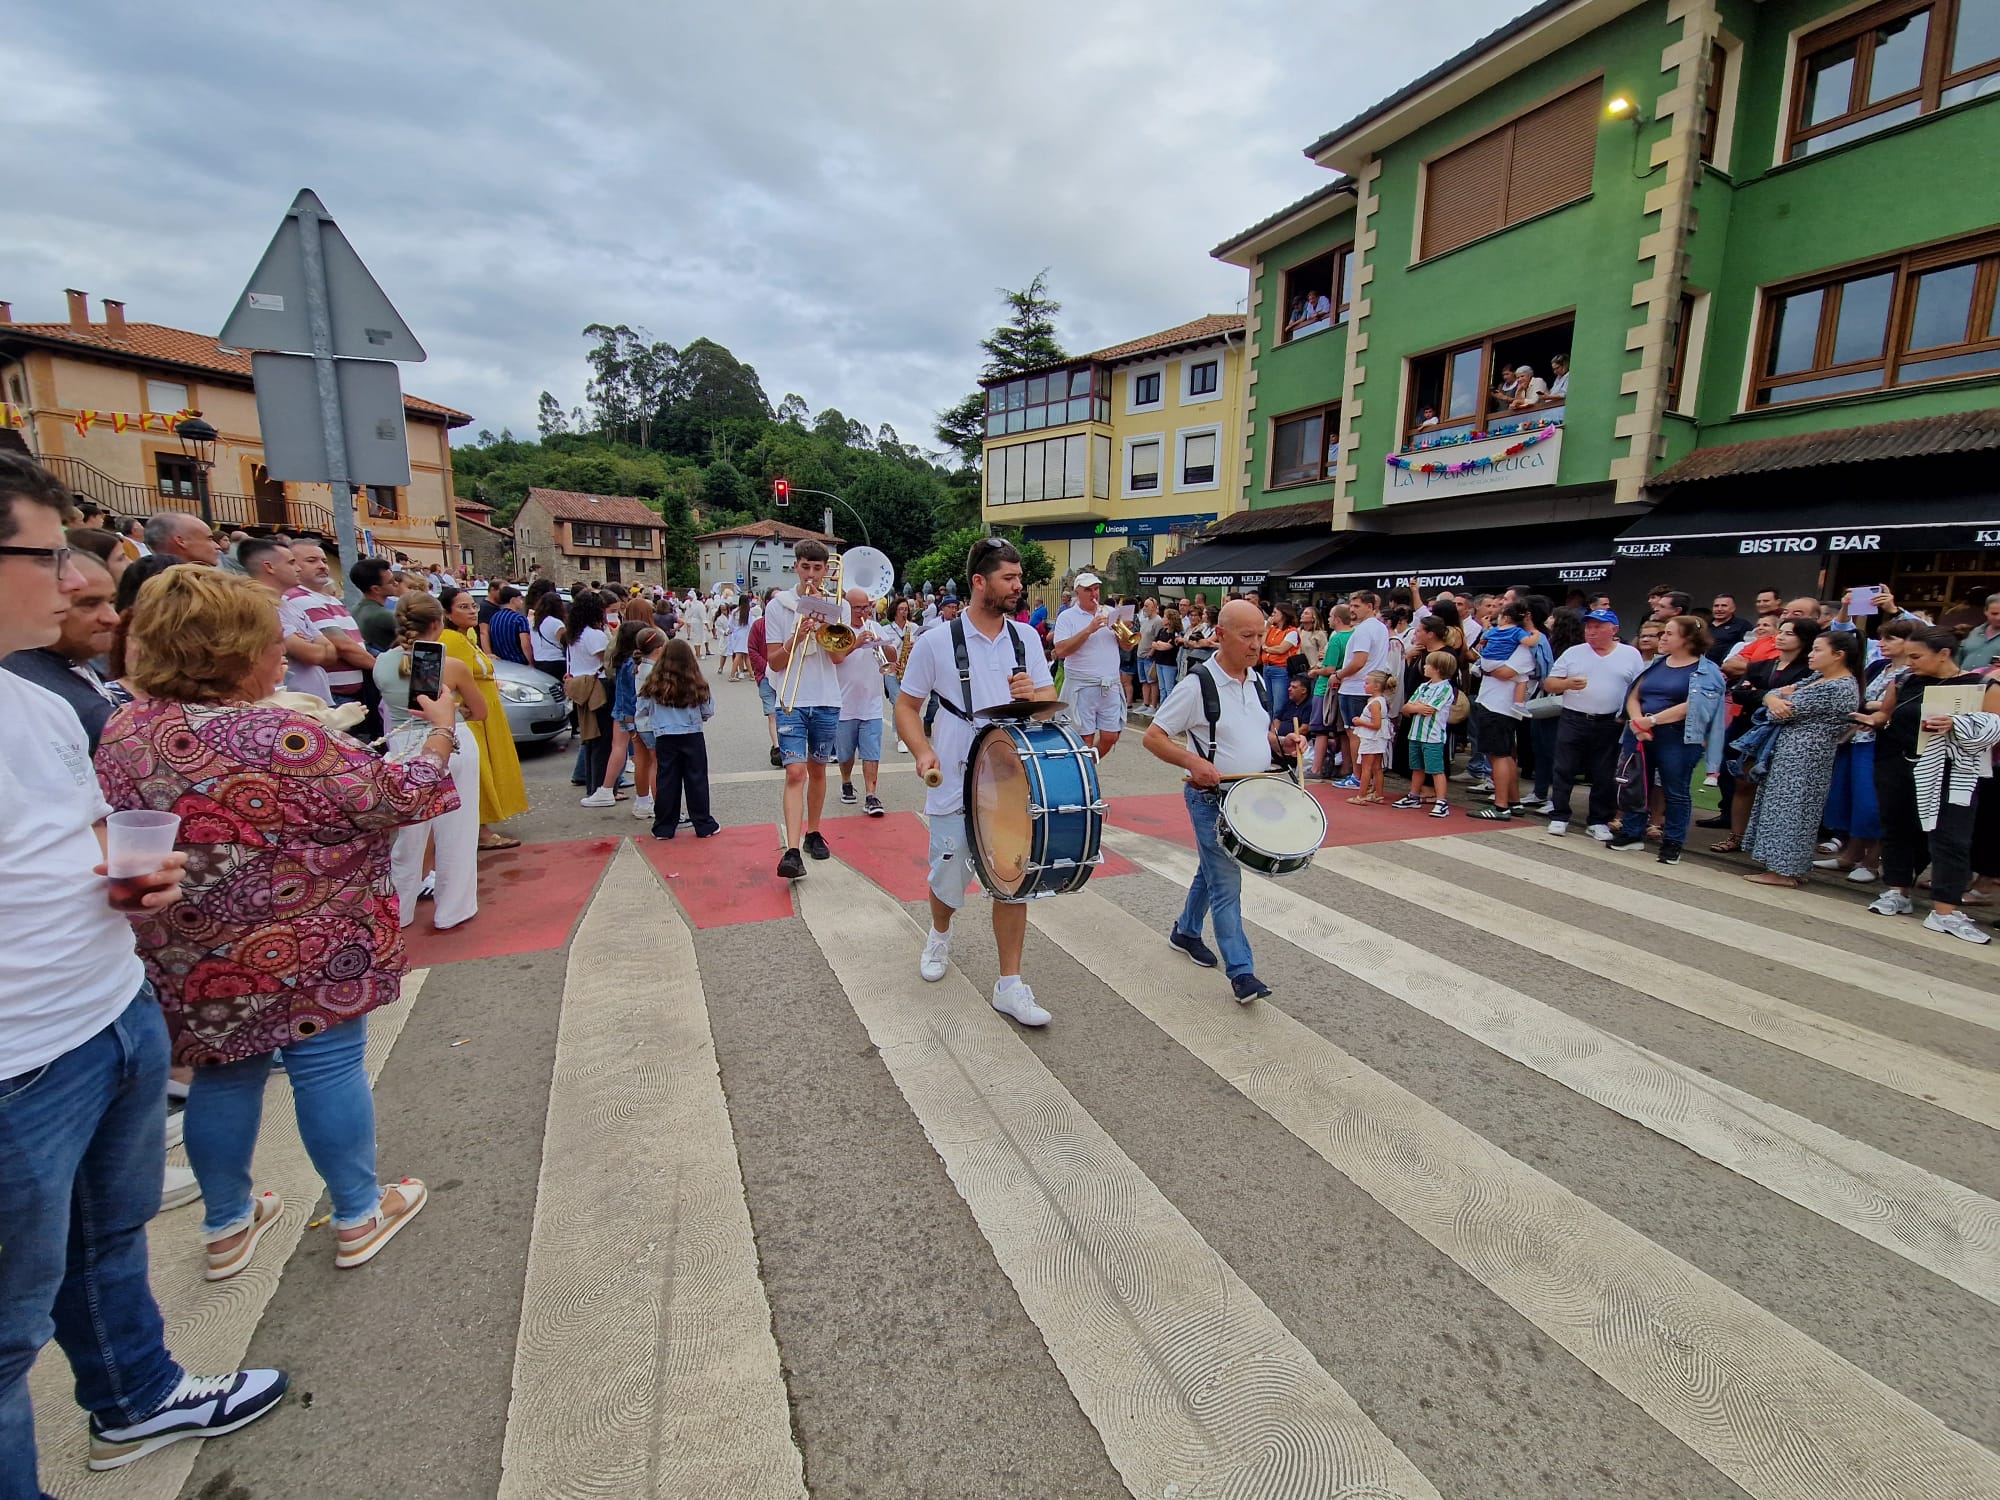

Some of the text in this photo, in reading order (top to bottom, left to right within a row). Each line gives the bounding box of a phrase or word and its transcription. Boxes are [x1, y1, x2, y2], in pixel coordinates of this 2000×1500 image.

[1105, 525, 1129, 534] Unicaja
[1616, 543, 1671, 553] KELER
[1740, 535, 1880, 553] BISTRO BAR
[1559, 568, 1607, 579] KELER
[1162, 575, 1234, 585] COCINA DE MERCADO
[1288, 581, 1315, 589] KELER
[1376, 575, 1464, 589] LA PAENTUCA
